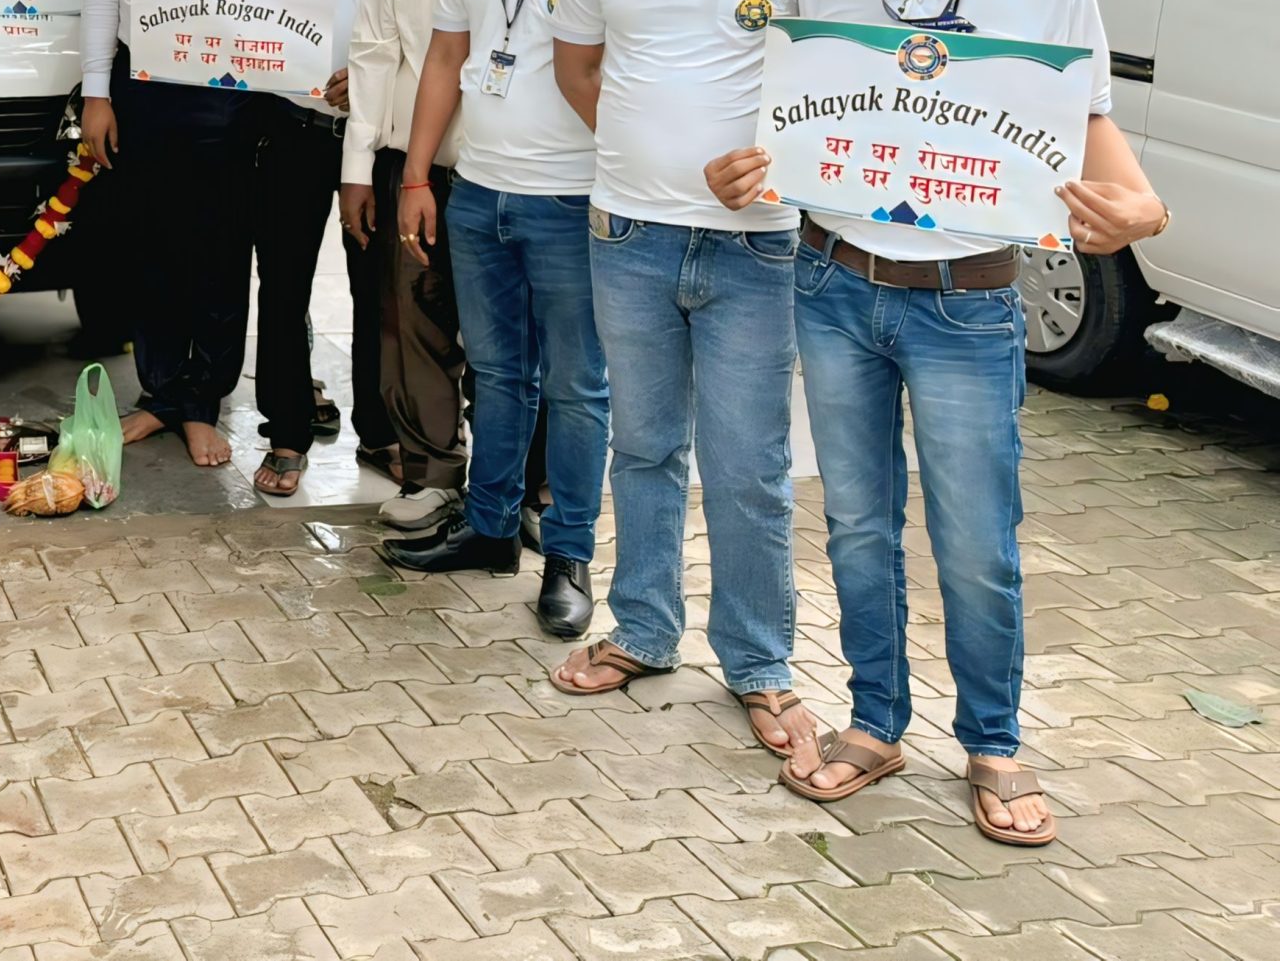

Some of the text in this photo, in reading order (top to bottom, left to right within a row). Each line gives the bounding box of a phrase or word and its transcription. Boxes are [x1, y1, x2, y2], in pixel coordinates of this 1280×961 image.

[175, 33, 192, 48] घर
[205, 36, 221, 48] घर
[277, 8, 323, 47] India
[201, 52, 218, 64] घर
[772, 85, 1067, 173] Sahayak Rojgar India
[825, 137, 1001, 180] घर घर रोजगार
[818, 162, 1001, 207] हर घर खुशहाल
